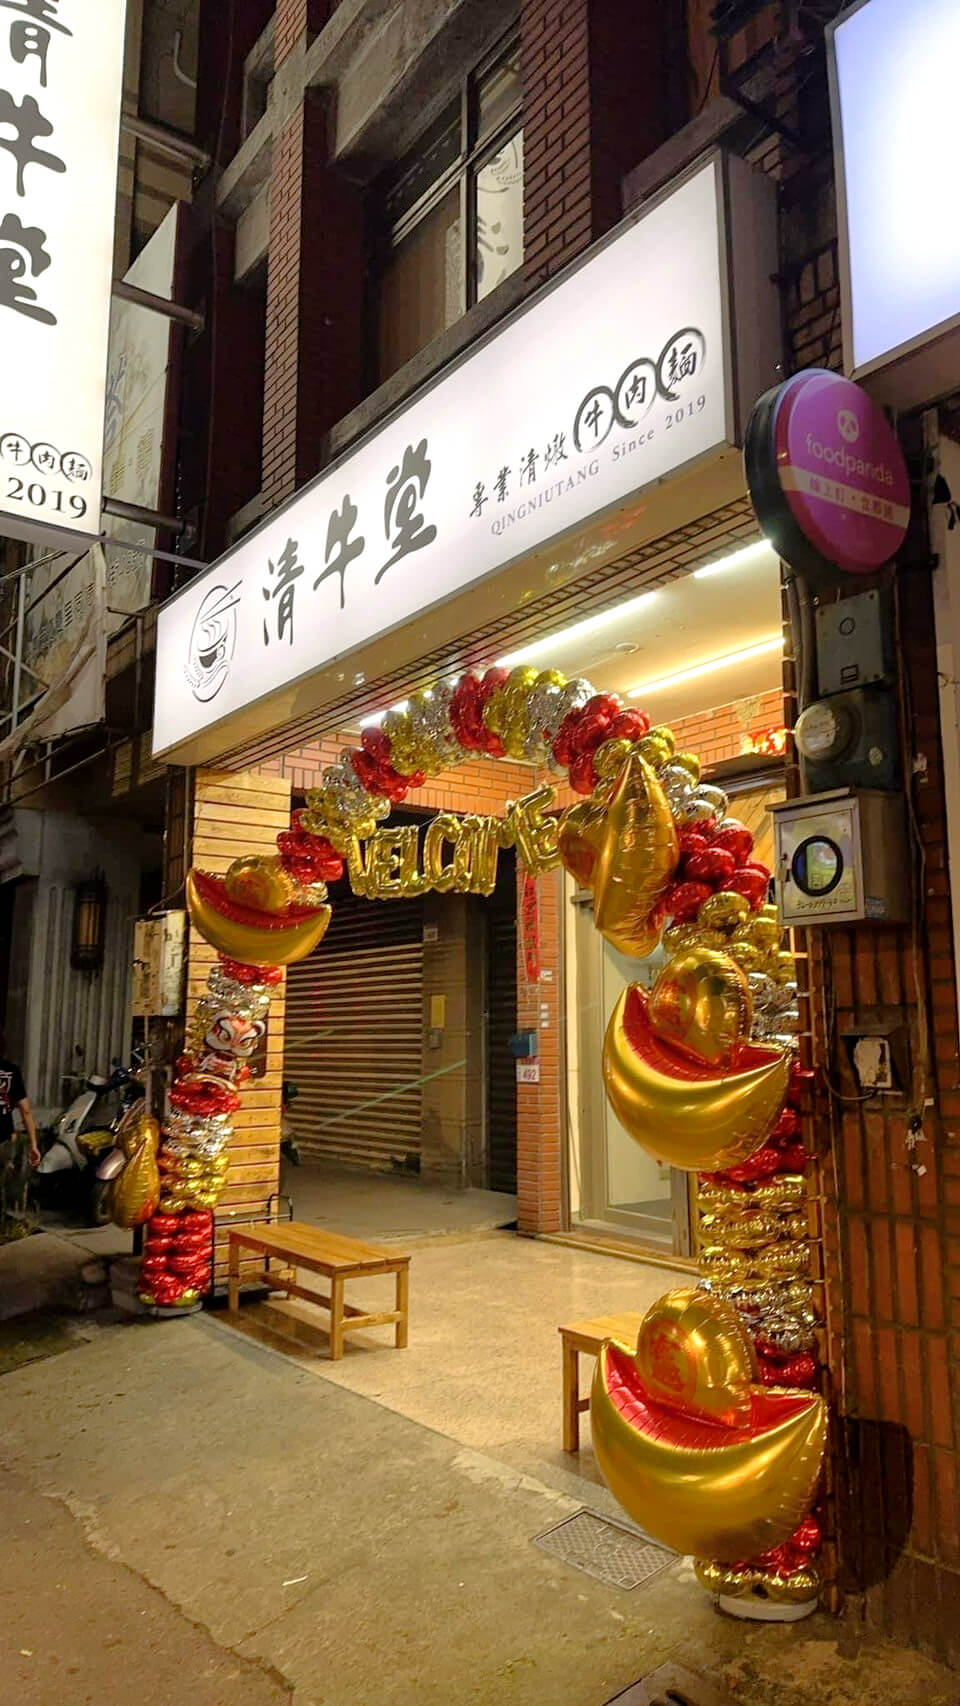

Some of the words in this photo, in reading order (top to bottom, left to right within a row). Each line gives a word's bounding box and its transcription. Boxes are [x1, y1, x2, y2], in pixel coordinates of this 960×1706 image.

[5, 476, 88, 519] 2019
[491, 459, 601, 536] QINGNIUTANG
[612, 429, 655, 463] Since
[664, 394, 707, 431] 2019
[805, 433, 893, 486] foodpanda
[262, 438, 437, 646] 清牛堂
